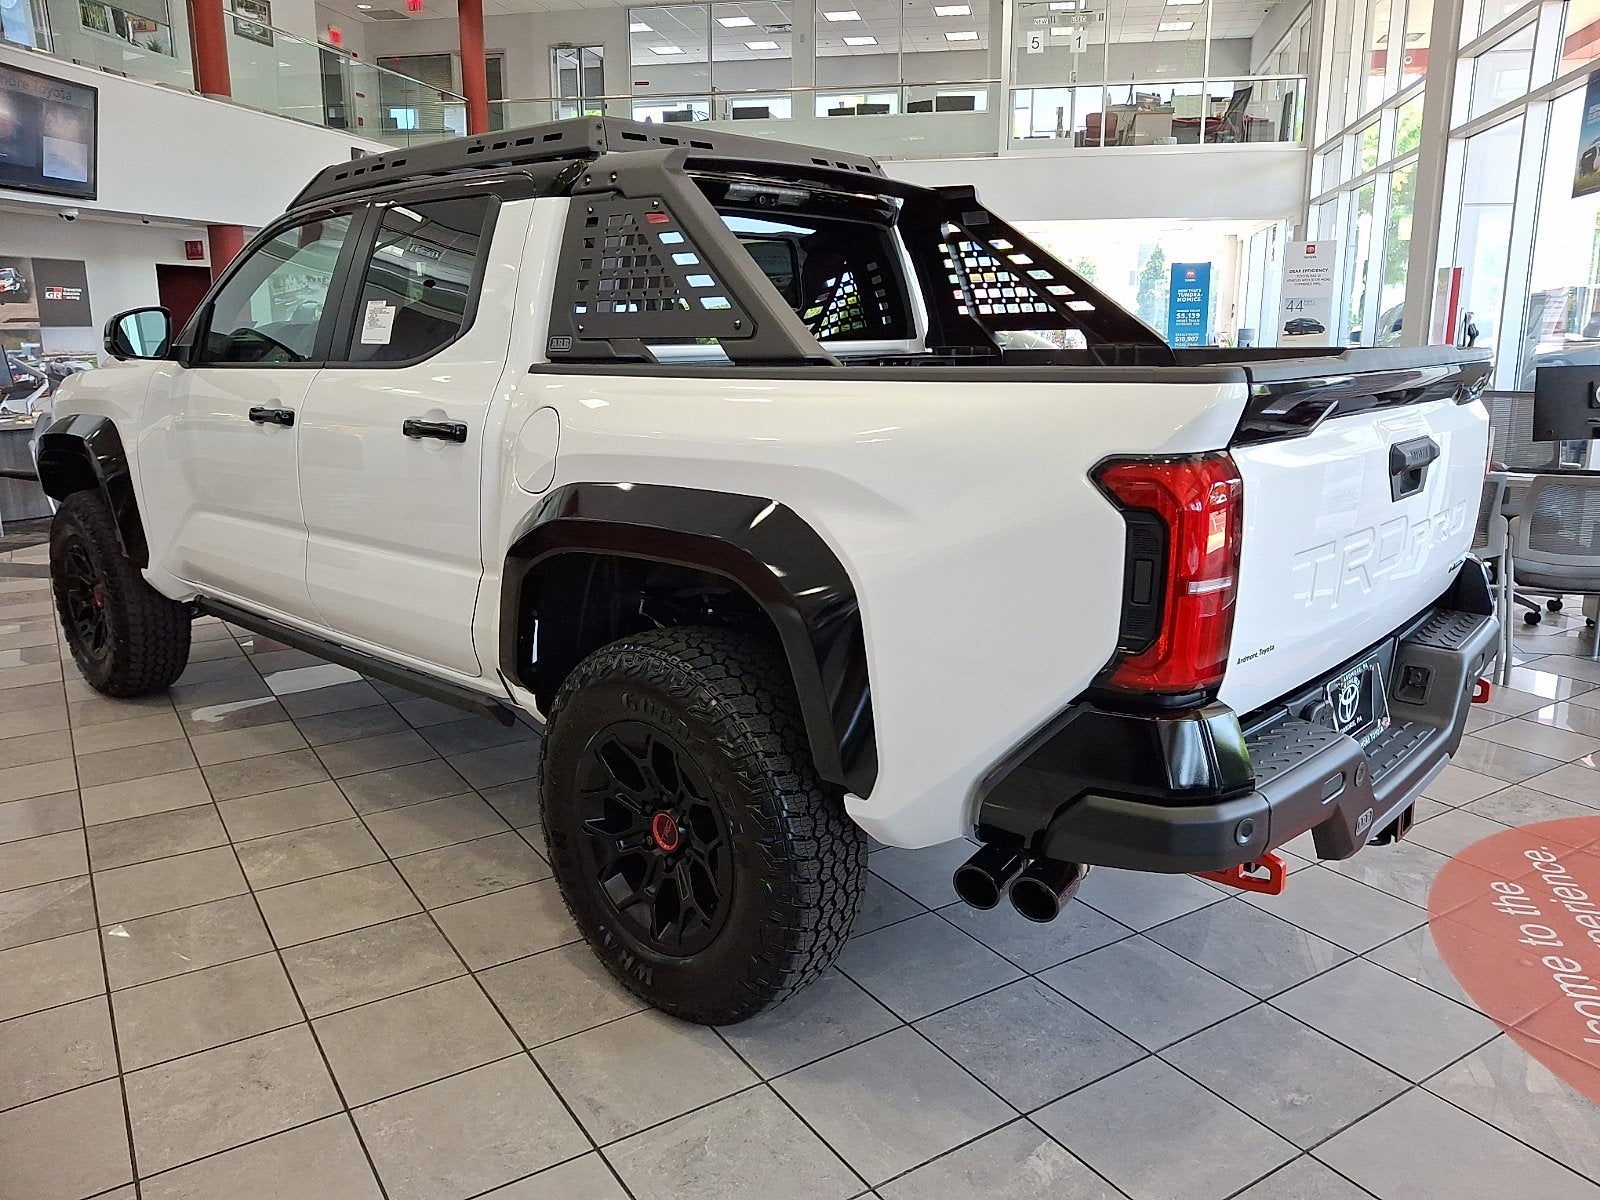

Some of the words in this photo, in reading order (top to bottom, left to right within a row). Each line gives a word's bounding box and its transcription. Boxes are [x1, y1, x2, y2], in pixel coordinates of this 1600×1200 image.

[1031, 36, 1040, 50] 5
[1075, 35, 1082, 49] 1
[1286, 299, 1304, 312] 44
[550, 337, 571, 349] ARB
[1490, 881, 1541, 916] the
[1517, 923, 1564, 947] to
